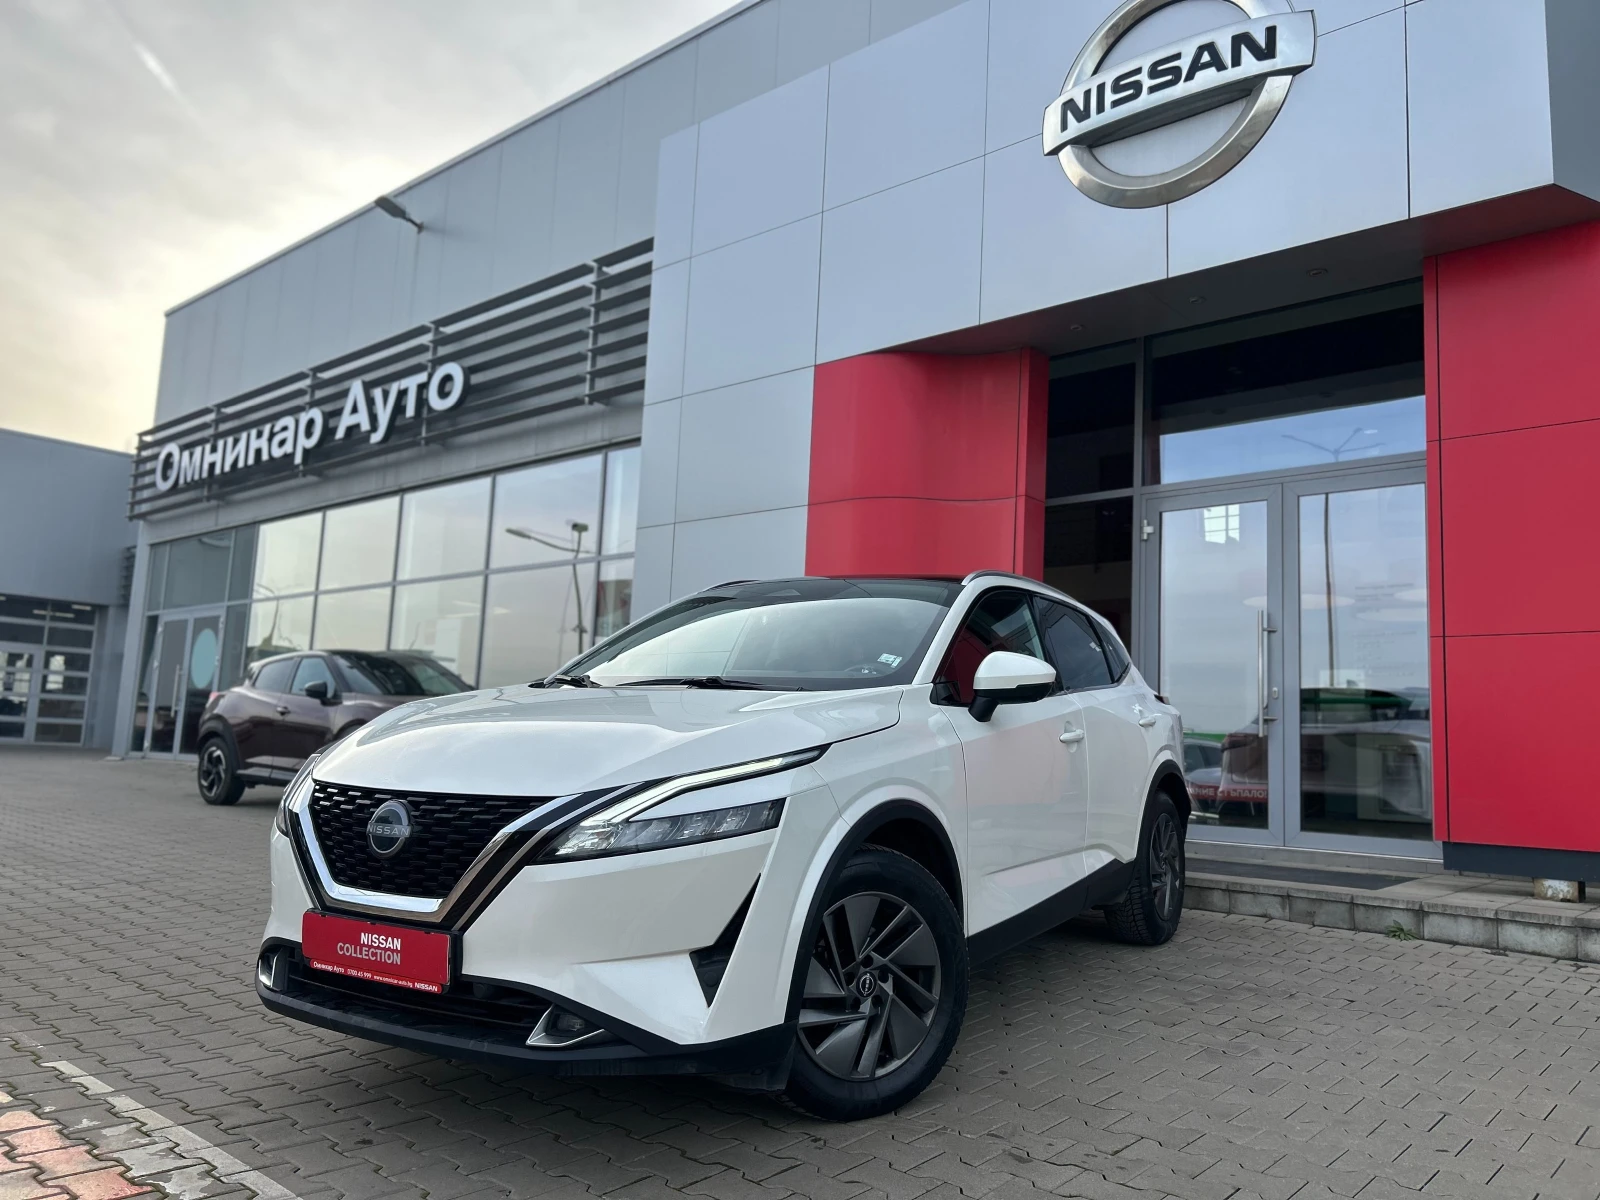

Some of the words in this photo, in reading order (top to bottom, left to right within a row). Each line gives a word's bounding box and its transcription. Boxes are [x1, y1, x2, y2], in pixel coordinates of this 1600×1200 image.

[1060, 25, 1277, 133] NISSAN
[155, 406, 325, 491] Омникар
[334, 361, 465, 444] Ауто
[367, 824, 410, 836] NISSAN
[360, 932, 401, 950] NISSAN
[337, 942, 401, 965] COLLECTION
[414, 981, 438, 992] NISSAN
